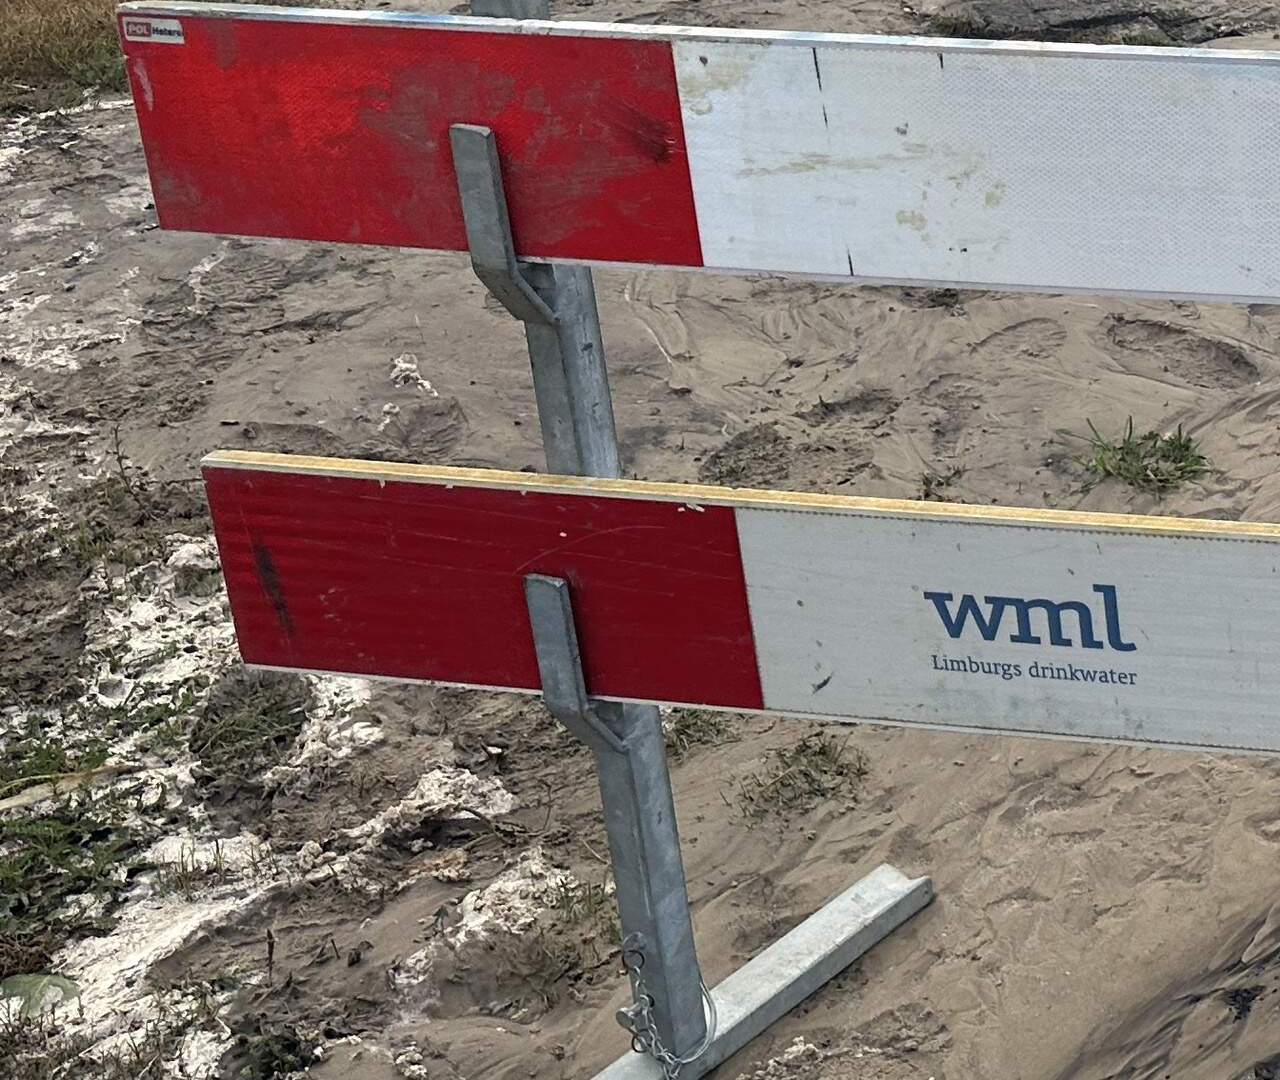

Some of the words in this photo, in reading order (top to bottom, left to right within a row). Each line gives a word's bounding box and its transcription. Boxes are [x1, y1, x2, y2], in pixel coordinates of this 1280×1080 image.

[923, 583, 1137, 651] wml
[931, 654, 1022, 681] Limburgs
[1029, 661, 1138, 685] drinkwater
